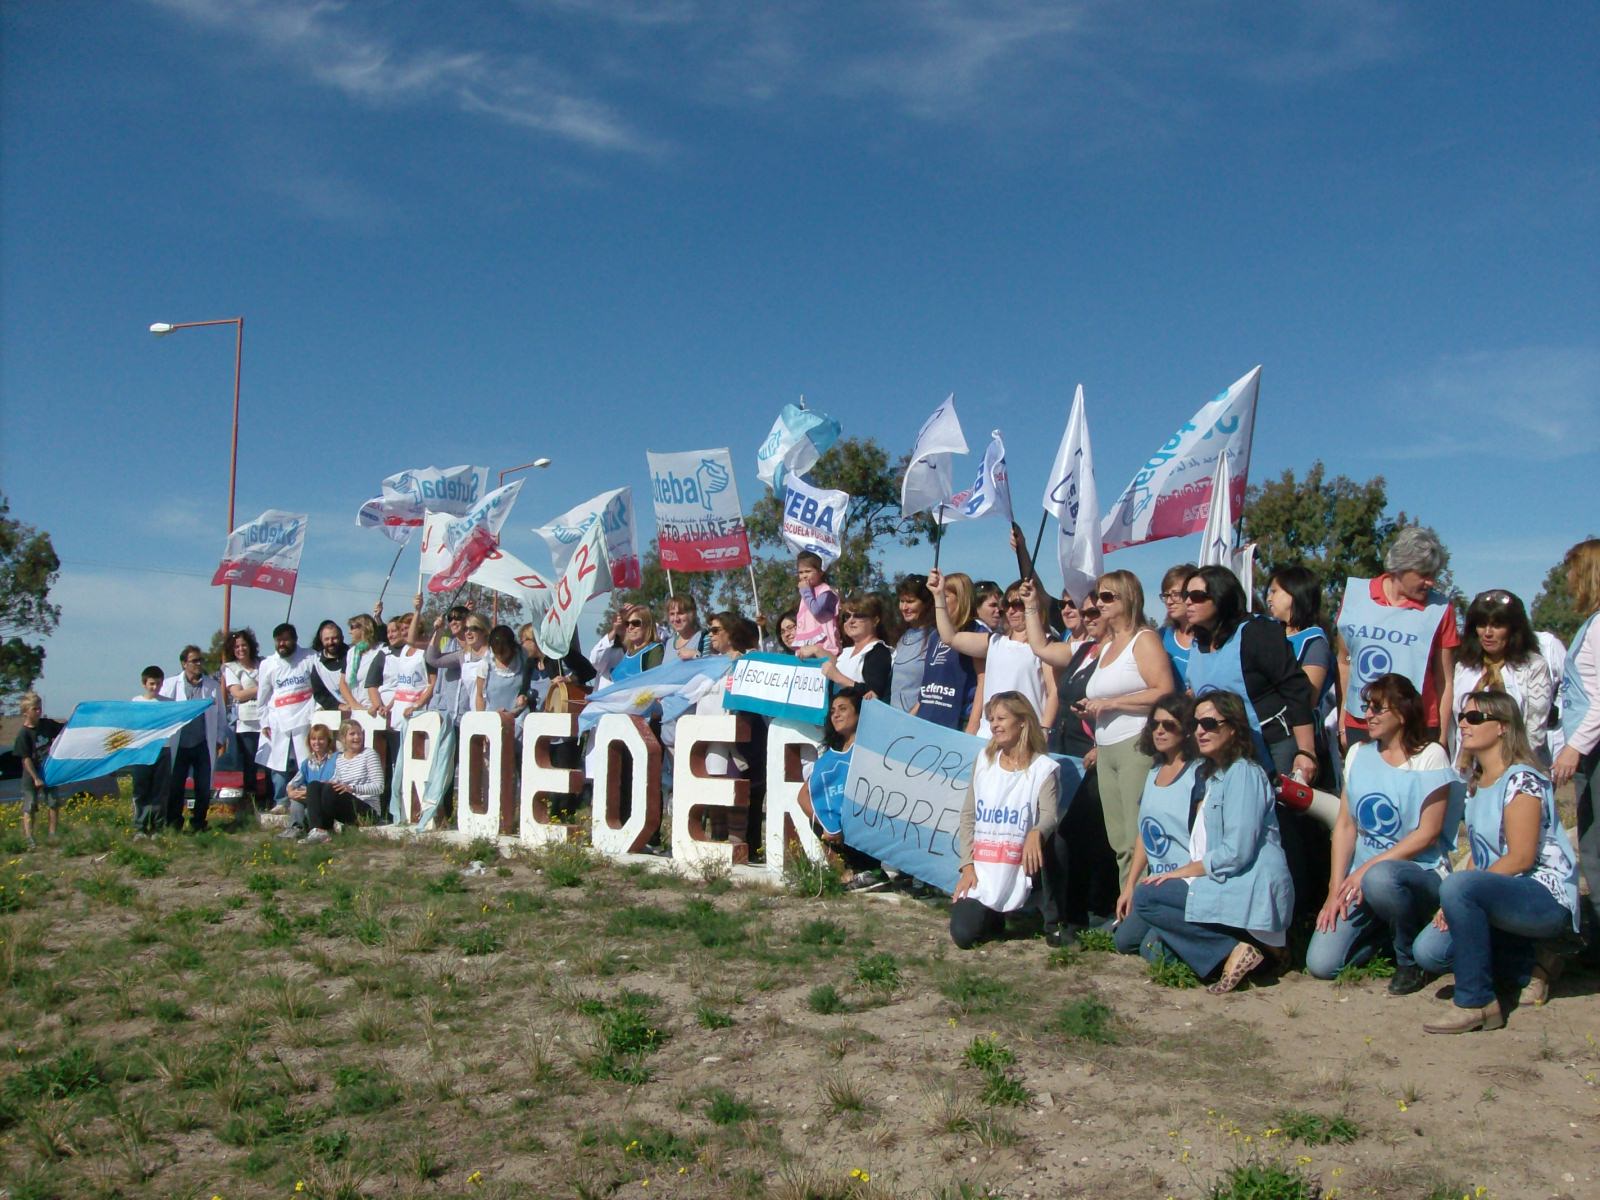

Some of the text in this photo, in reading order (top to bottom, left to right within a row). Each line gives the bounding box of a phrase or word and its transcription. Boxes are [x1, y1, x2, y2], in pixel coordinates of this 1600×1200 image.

[1347, 623, 1418, 646] SADOP
[745, 669, 790, 689] ESCUELA
[975, 799, 1019, 825] Suteba
